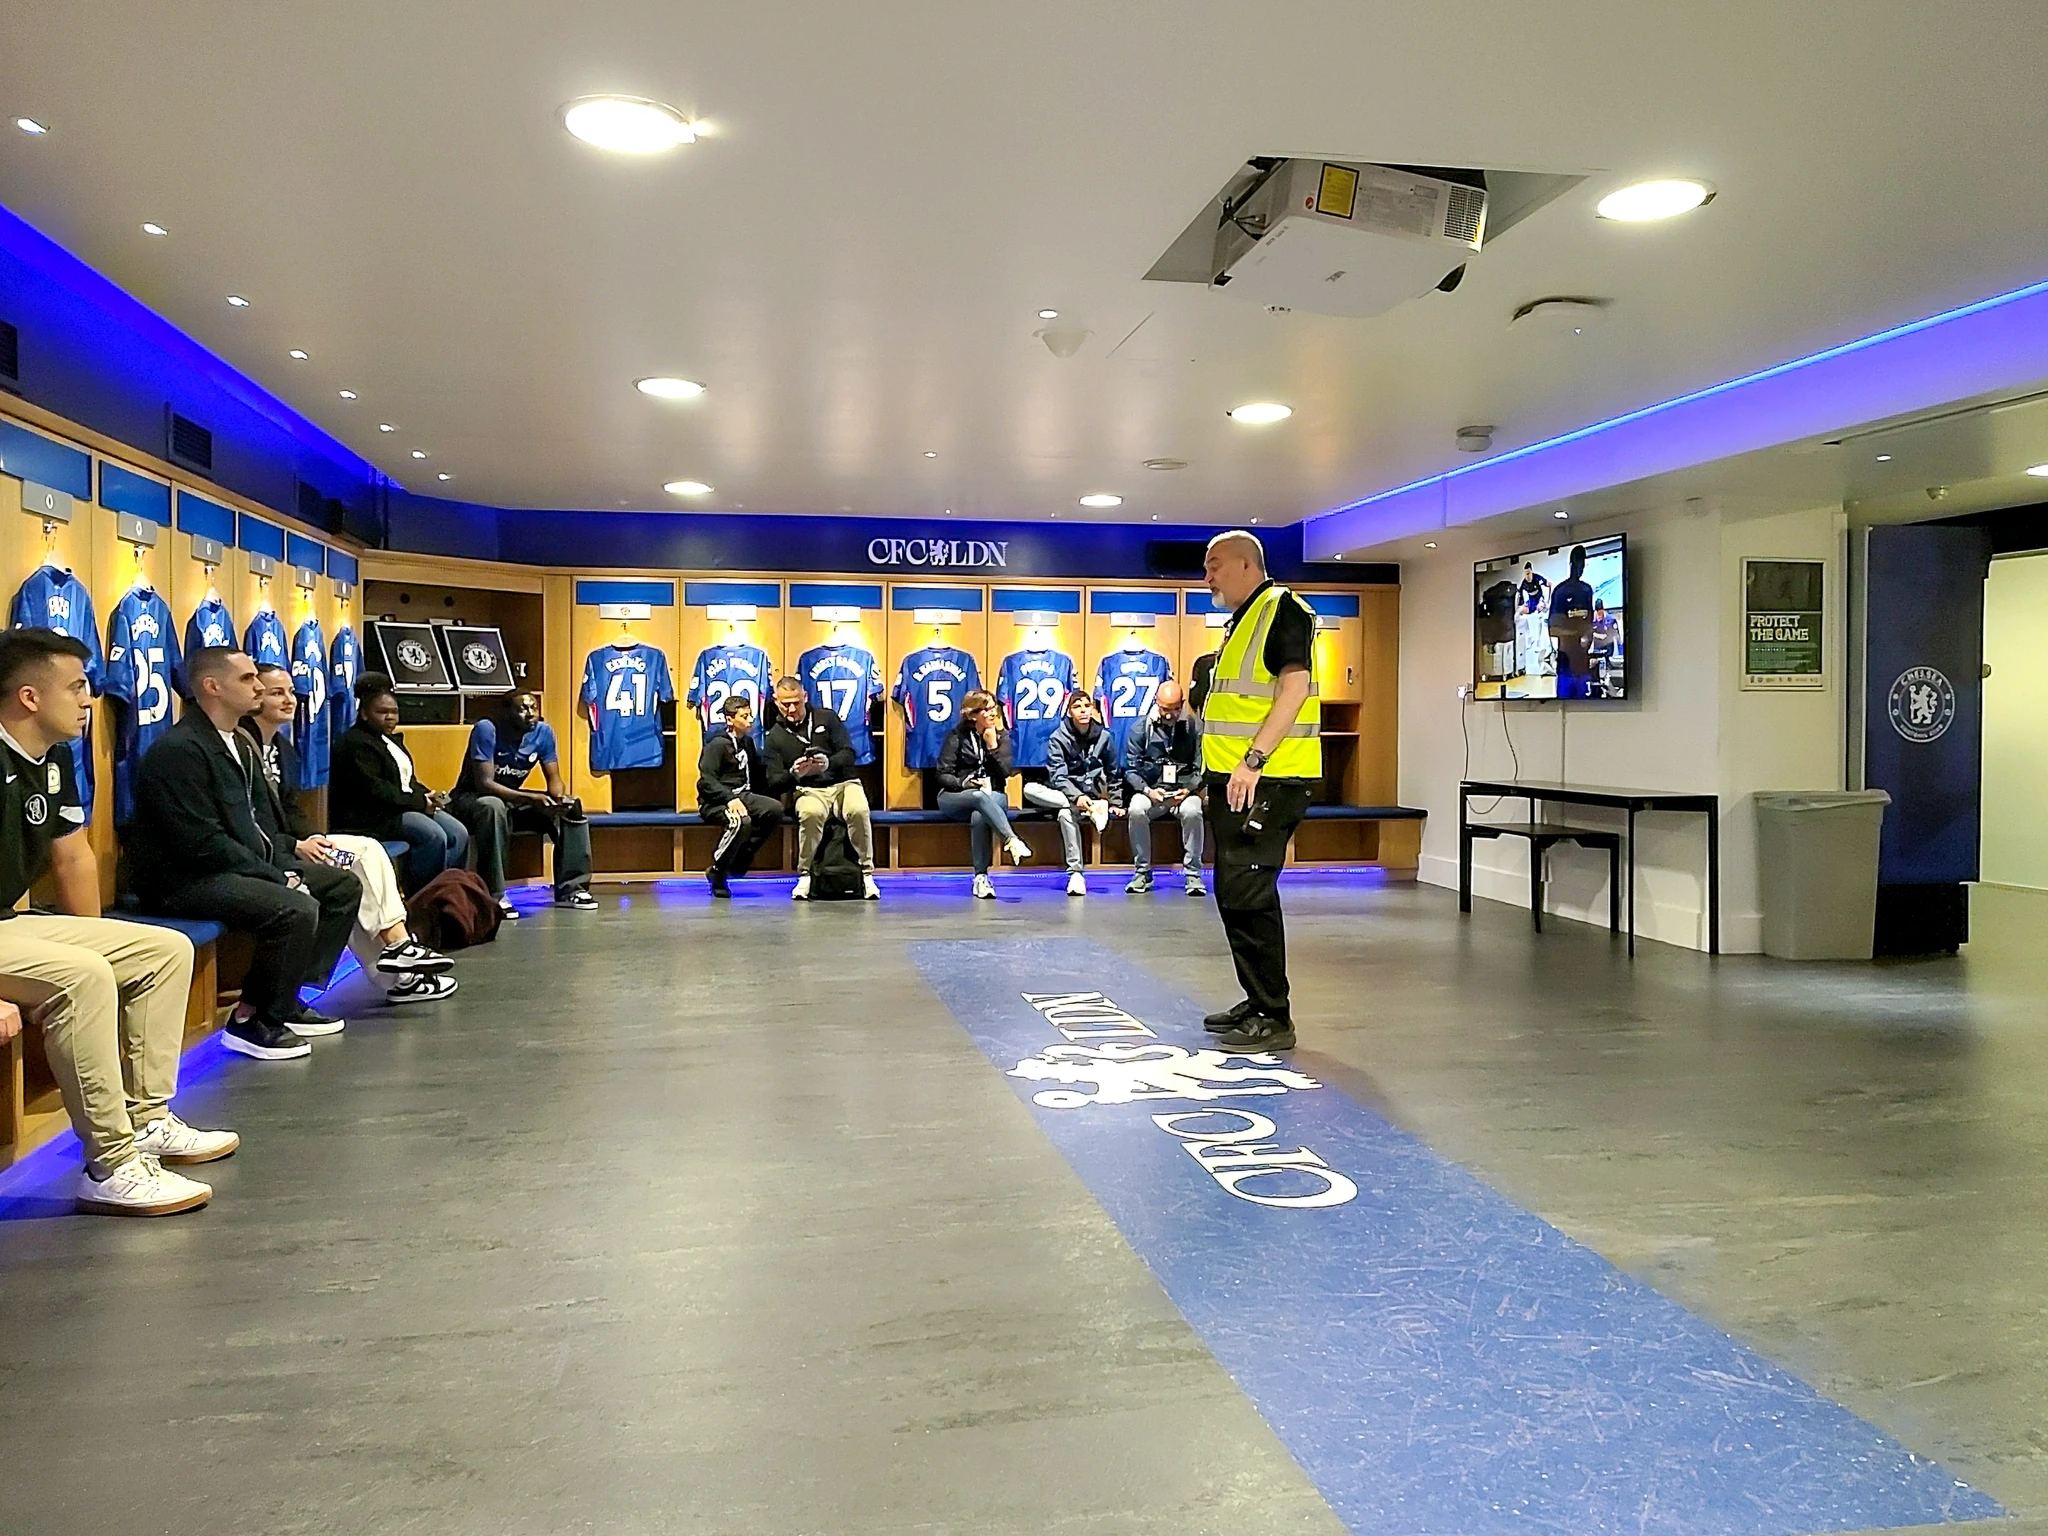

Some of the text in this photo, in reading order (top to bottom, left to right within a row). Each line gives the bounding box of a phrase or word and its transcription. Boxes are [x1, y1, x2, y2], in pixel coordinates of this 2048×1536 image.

[868, 538, 1009, 567] CFC LDN
[1750, 615, 1800, 627] PROTECT
[1750, 628, 1808, 640] THE GAME
[605, 673, 647, 717] 41
[707, 680, 758, 724] 20
[817, 680, 858, 721] 17
[928, 681, 952, 722] 5
[1016, 677, 1064, 719] 29
[1112, 675, 1159, 717] 27
